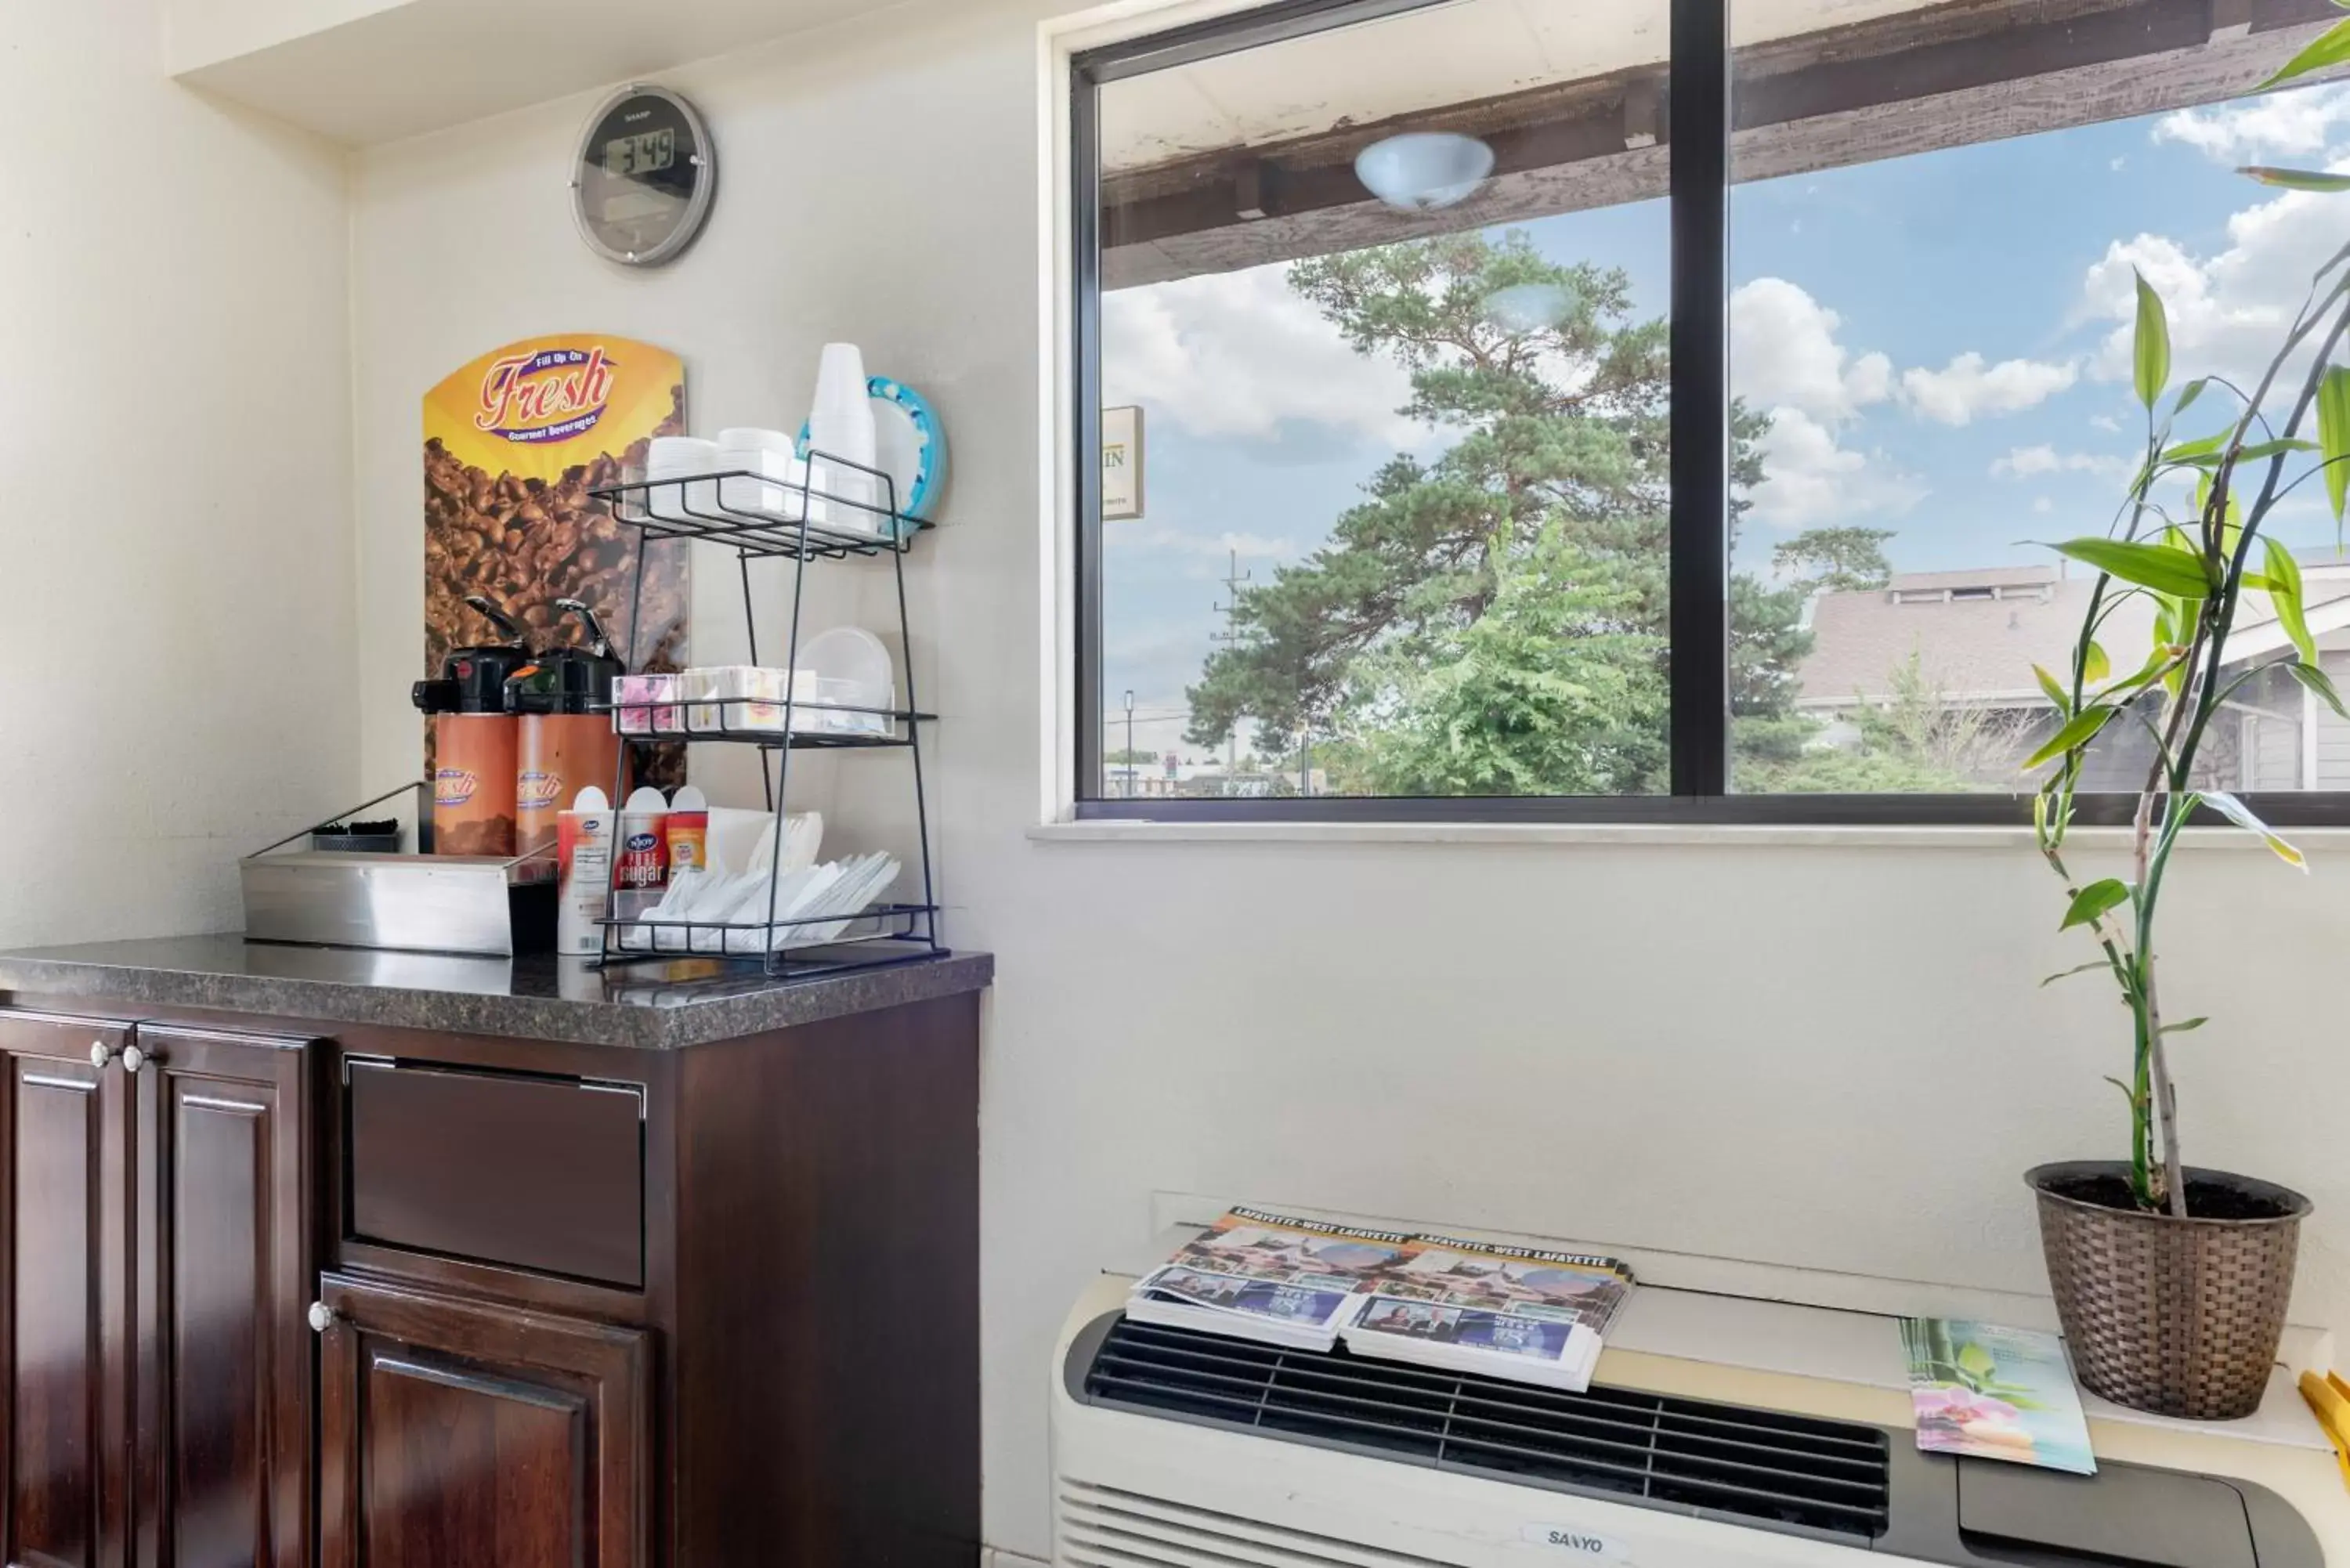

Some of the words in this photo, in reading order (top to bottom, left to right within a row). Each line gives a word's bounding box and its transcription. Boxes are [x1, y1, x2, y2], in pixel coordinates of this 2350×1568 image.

[537, 356, 551, 367] Fill
[554, 353, 566, 363] Up
[569, 350, 582, 361] On
[474, 346, 613, 431] Fresh
[508, 428, 547, 440] Gourmet
[620, 865, 663, 887] sugar
[1338, 1227, 1405, 1243] LAFAYETTE
[1535, 1250, 1607, 1266] LAFAYETTE
[1548, 1530, 1603, 1553] SANYO
